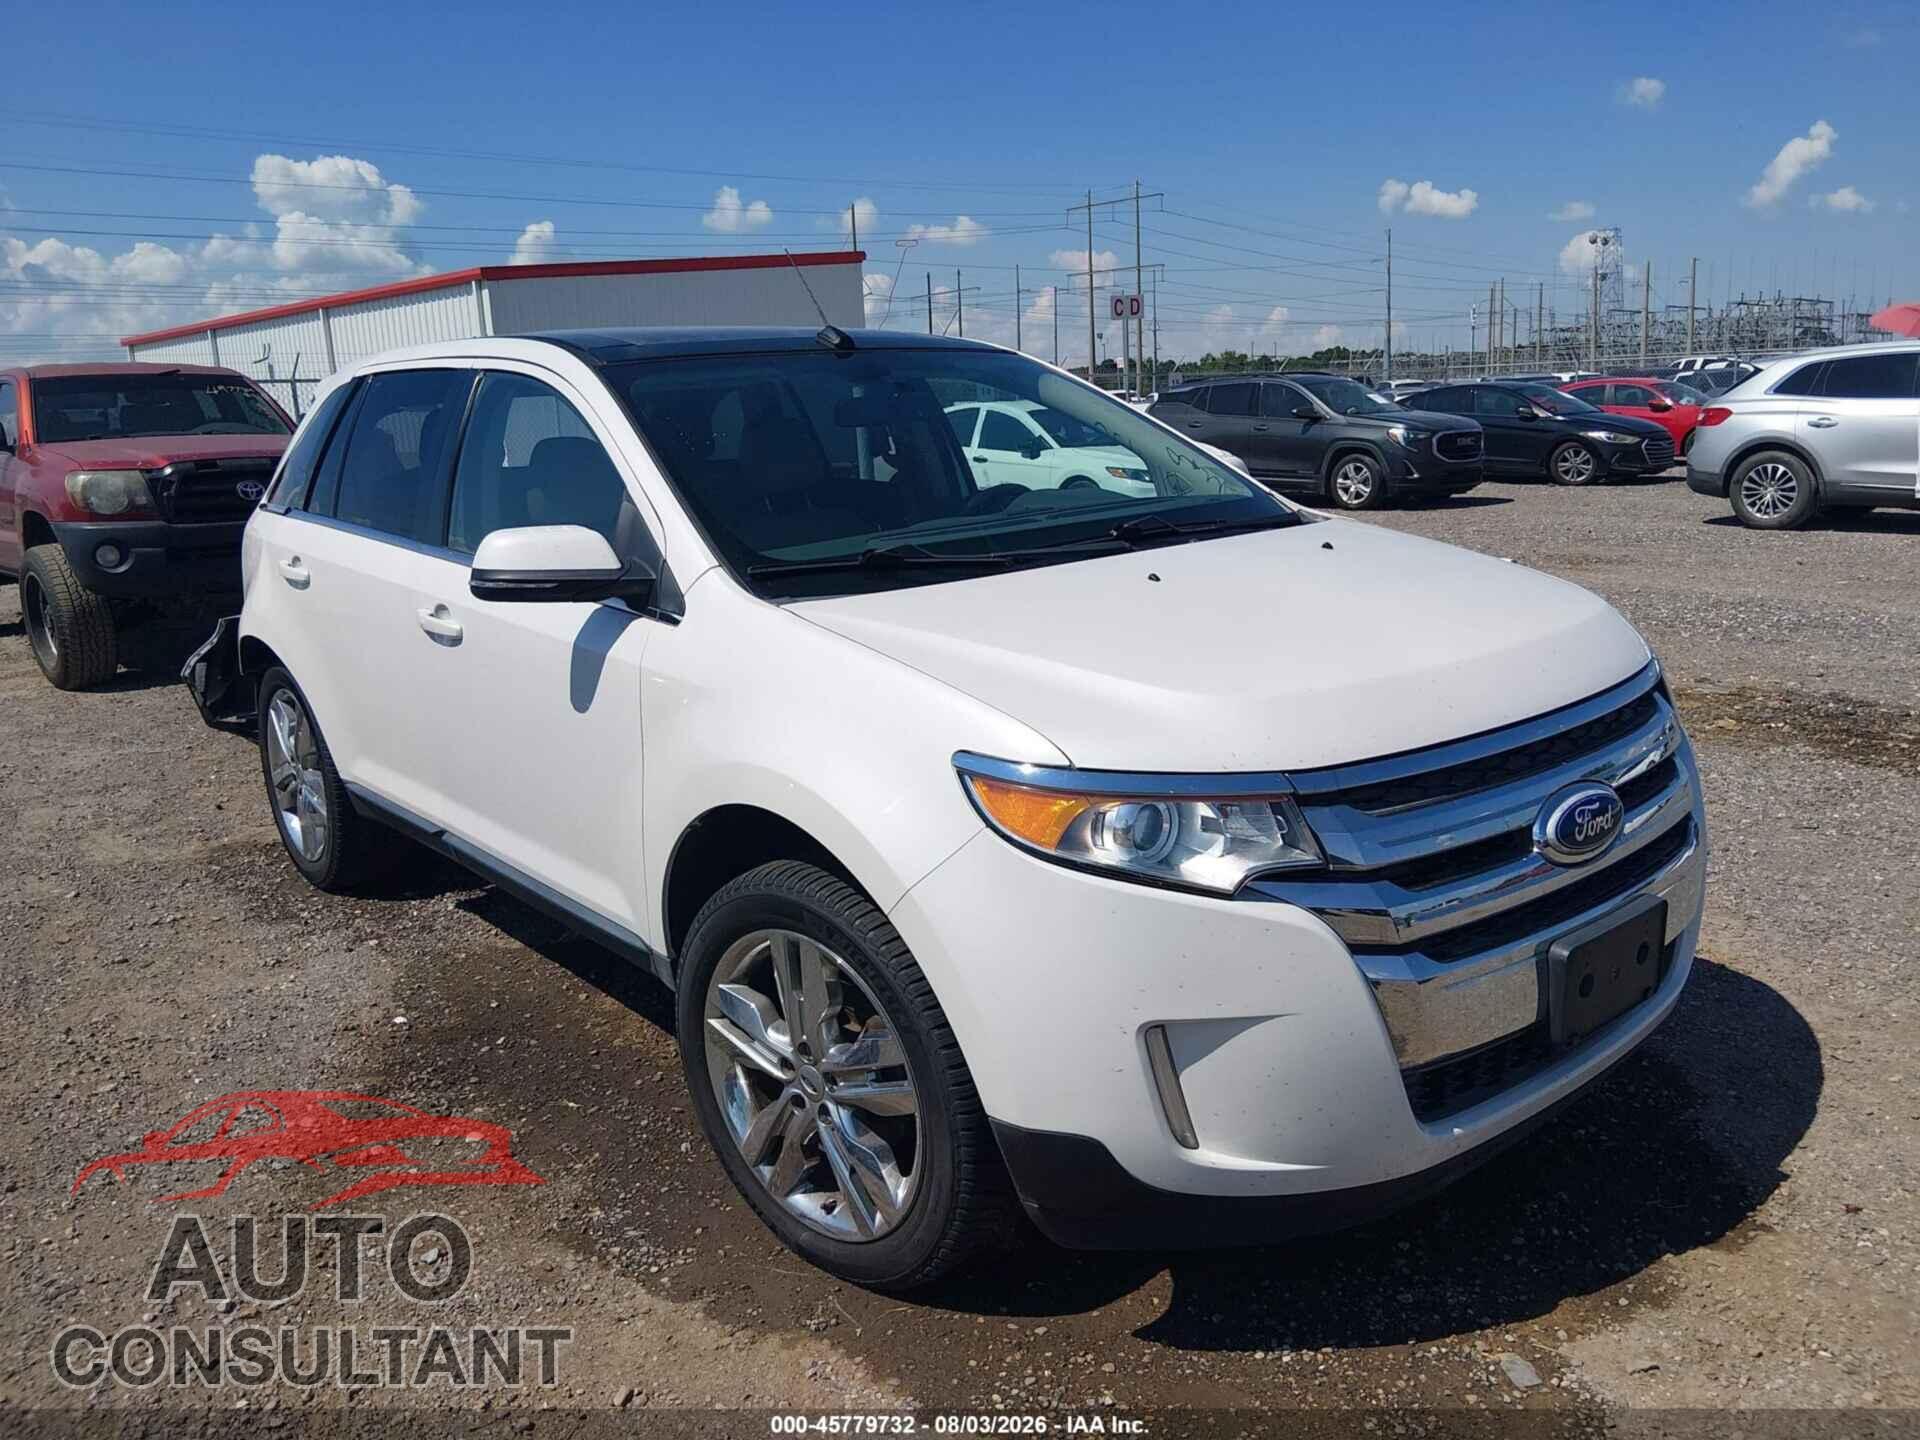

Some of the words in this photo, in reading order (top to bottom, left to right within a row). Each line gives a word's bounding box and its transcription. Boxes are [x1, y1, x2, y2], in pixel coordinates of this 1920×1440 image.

[1114, 298, 1124, 317] C
[1130, 298, 1140, 316] D
[1574, 801, 1615, 842] Ford
